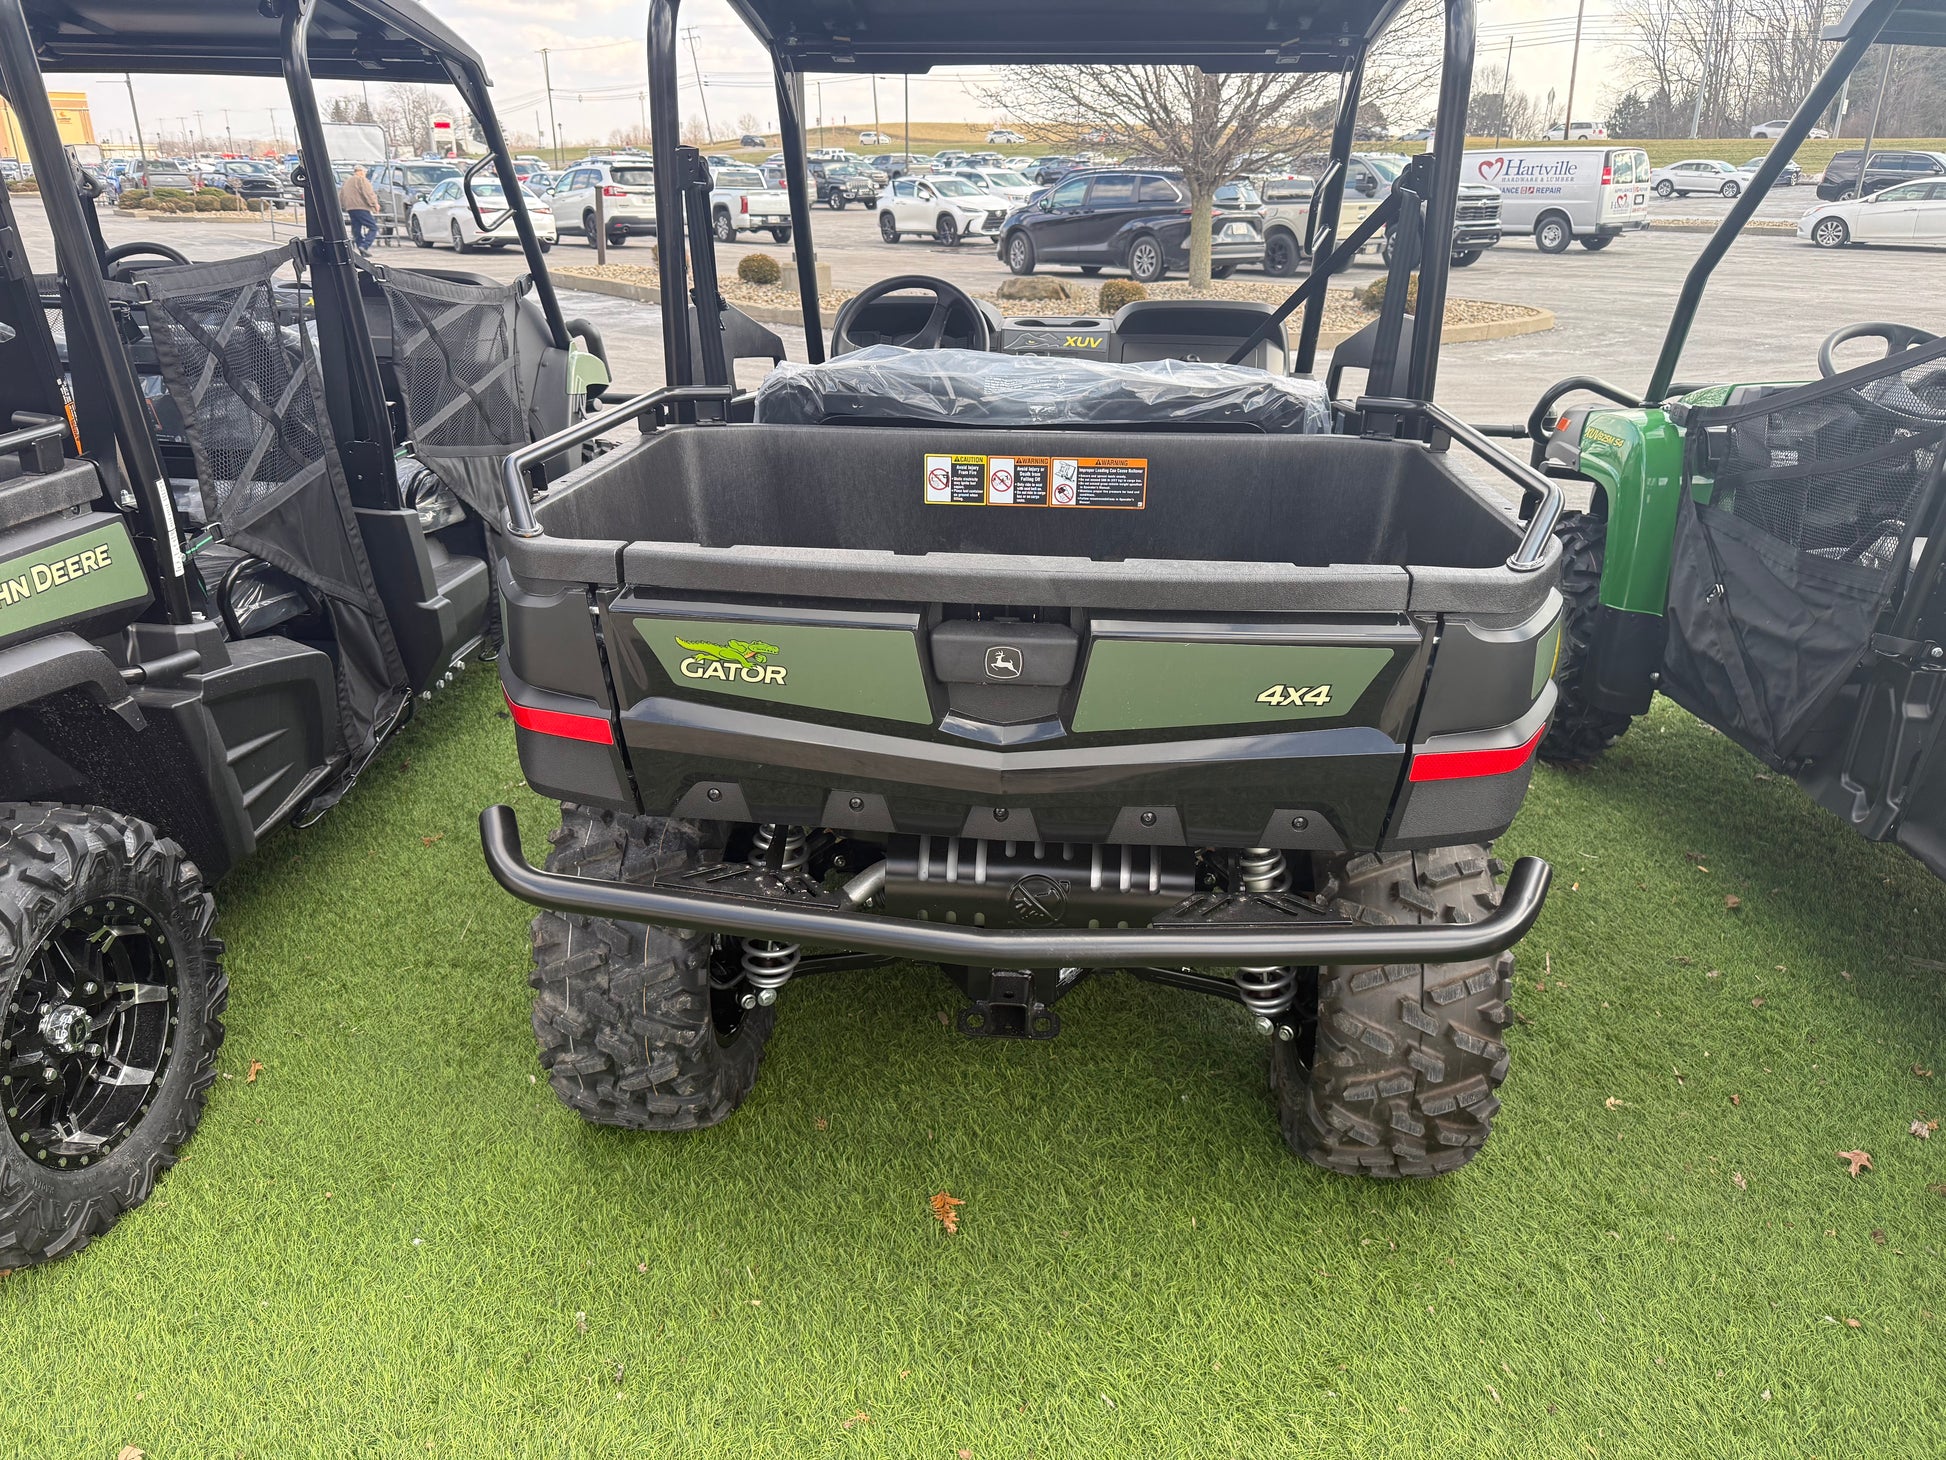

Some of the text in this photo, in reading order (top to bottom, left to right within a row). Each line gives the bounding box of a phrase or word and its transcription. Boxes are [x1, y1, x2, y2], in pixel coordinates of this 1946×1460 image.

[1503, 159, 1577, 176] Hartville
[1063, 335, 1103, 348] XUV
[1101, 459, 1129, 467] WARNING
[0, 543, 113, 609] HN DEERE
[680, 656, 788, 686] GATOR
[1255, 683, 1333, 706] 4x4
